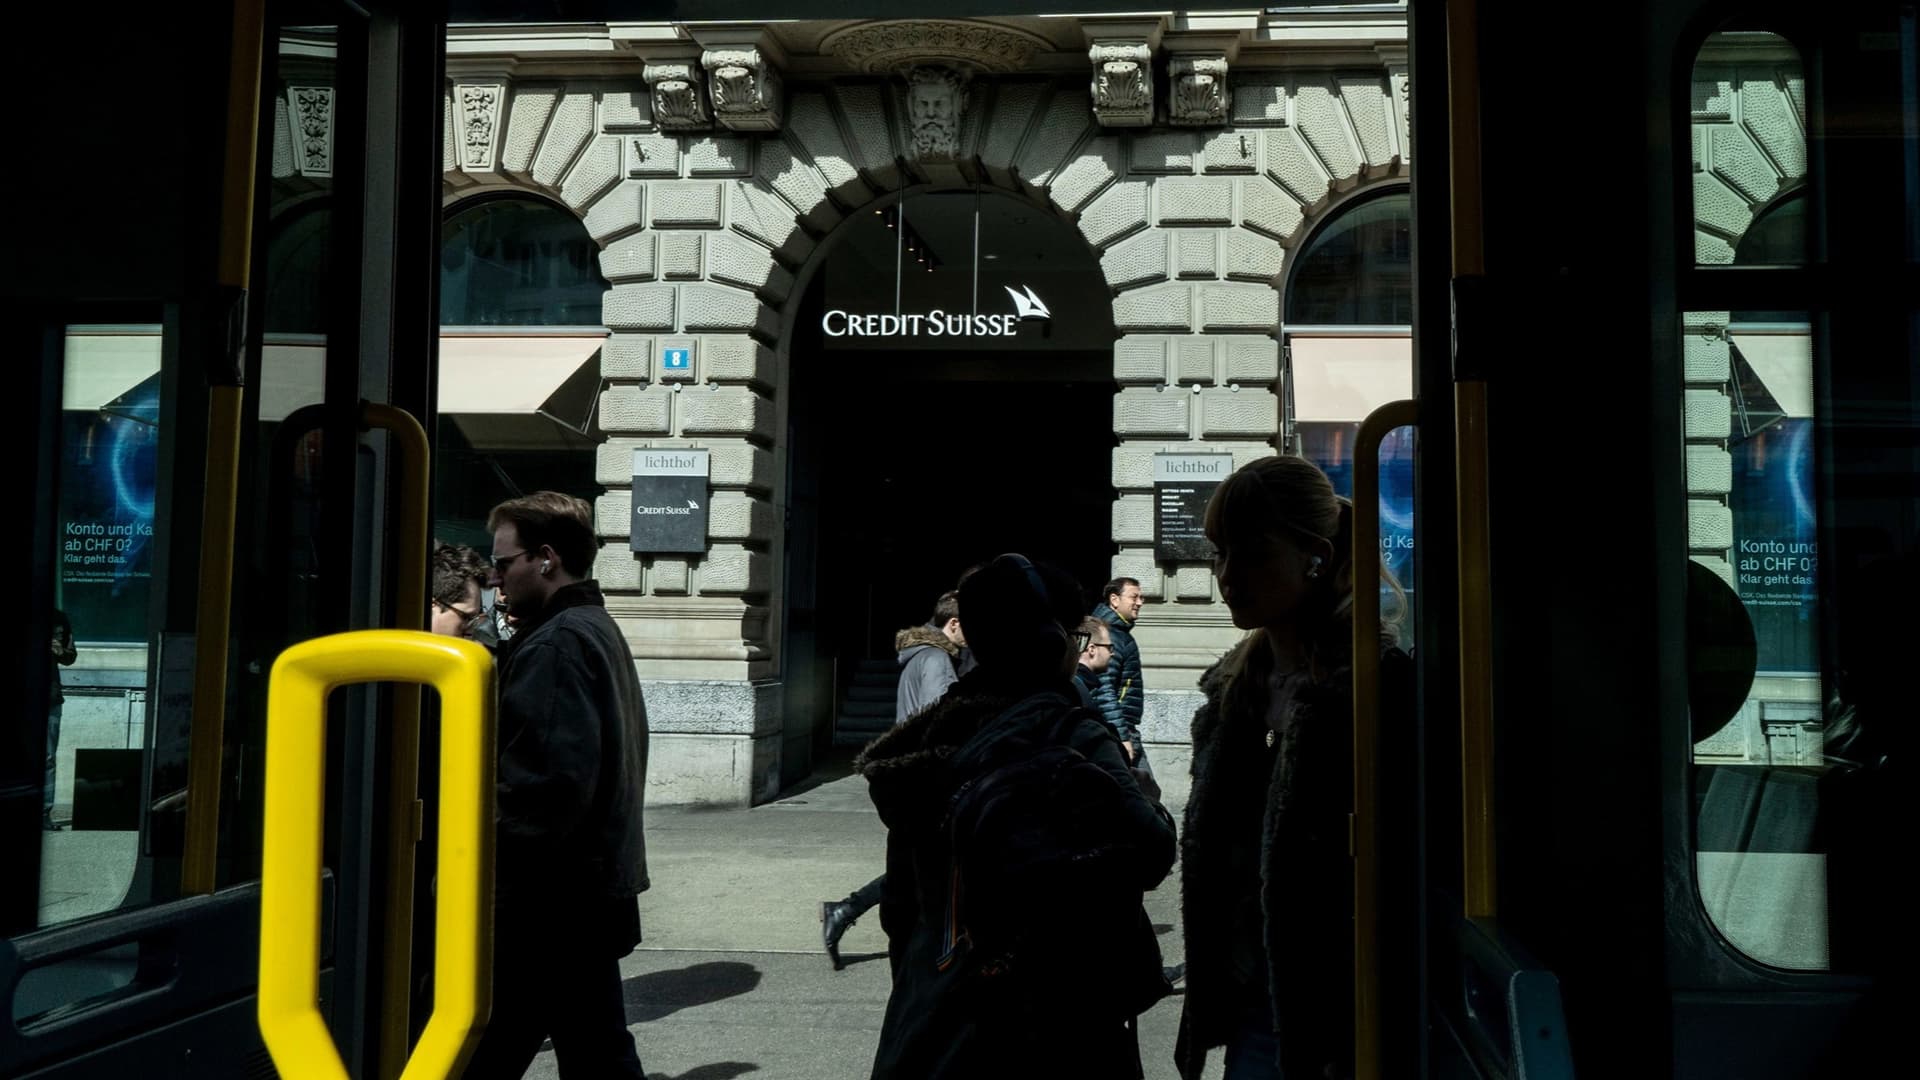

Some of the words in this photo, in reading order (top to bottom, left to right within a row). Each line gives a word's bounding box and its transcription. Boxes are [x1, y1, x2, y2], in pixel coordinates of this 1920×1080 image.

[822, 309, 924, 337] CREDIT
[927, 309, 1018, 337] SUISSE
[671, 351, 681, 366] 8
[645, 456, 696, 469] lichthof
[1165, 460, 1221, 473] lichthof
[637, 505, 665, 515] CREDIT
[666, 505, 691, 515] SUISSE
[66, 522, 105, 536] Konto
[107, 522, 133, 536] und
[136, 522, 153, 536] Ka
[65, 538, 82, 552] ab
[84, 538, 113, 552] CHF
[115, 538, 133, 552] 0?
[1397, 535, 1415, 549] Ka
[1740, 539, 1785, 554] Konto
[63, 553, 83, 564] Klar
[84, 554, 106, 566] geht
[107, 554, 128, 564] das.
[1740, 556, 1760, 571] ab
[1763, 557, 1797, 571] CHF
[1740, 573, 1761, 585] Klar
[1764, 574, 1789, 586] geht
